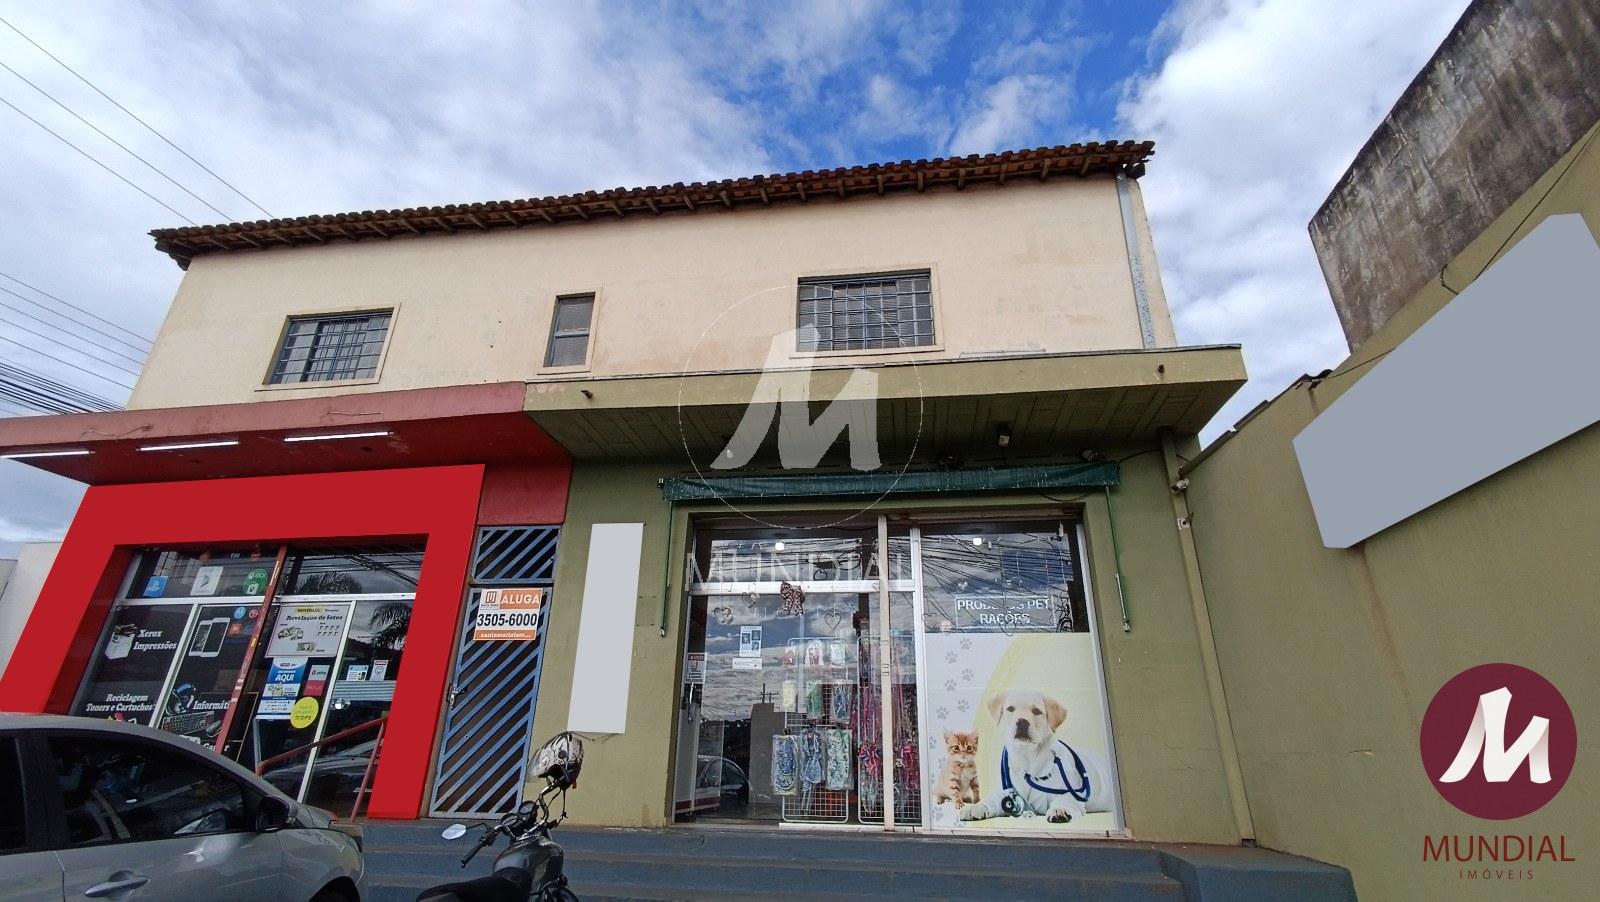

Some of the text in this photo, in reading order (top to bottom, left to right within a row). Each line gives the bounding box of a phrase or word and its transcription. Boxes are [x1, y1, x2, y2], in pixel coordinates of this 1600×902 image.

[501, 594, 540, 605] ALUGA
[1027, 599, 1050, 610] PET
[477, 613, 538, 627] 3505-6000
[138, 629, 163, 638] Xerox
[133, 641, 178, 652] Impressões
[275, 673, 295, 682] AQUI
[106, 693, 149, 703] Reciclagem
[85, 703, 111, 712] Toners
[116, 703, 153, 712] Cartuchos
